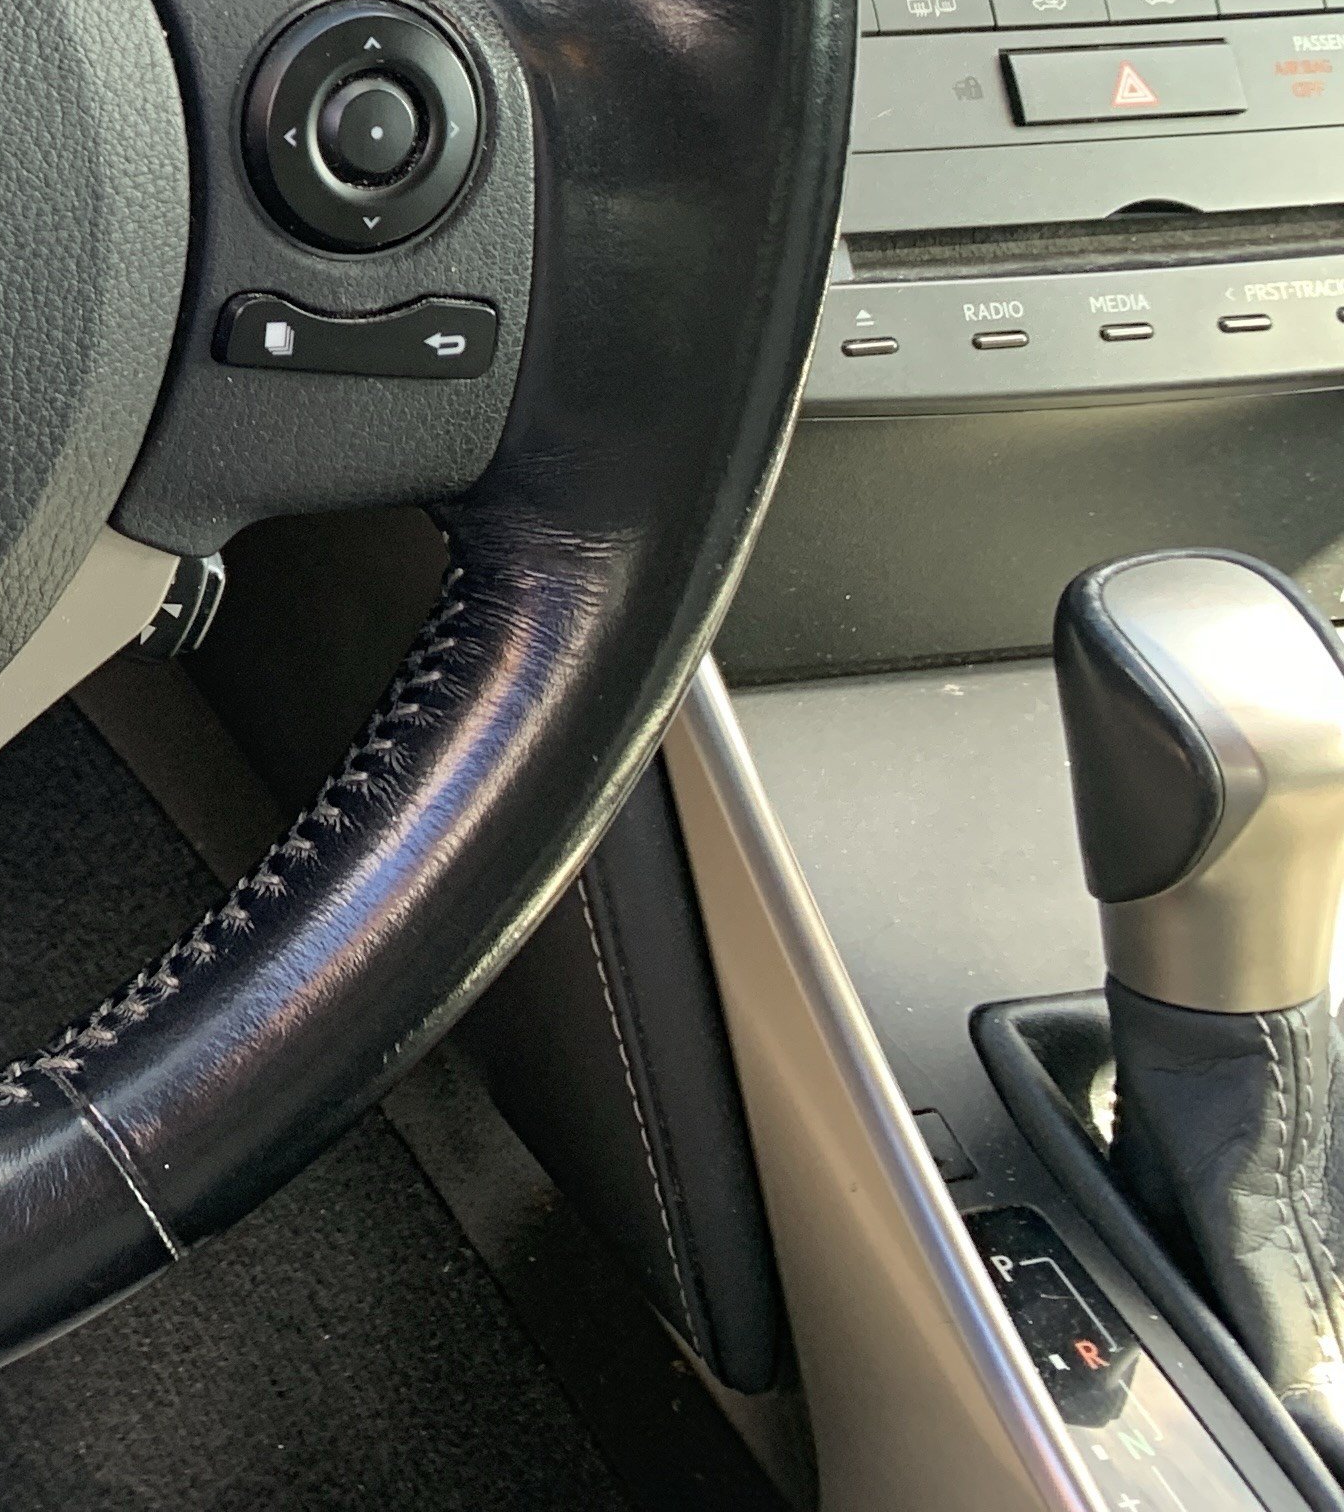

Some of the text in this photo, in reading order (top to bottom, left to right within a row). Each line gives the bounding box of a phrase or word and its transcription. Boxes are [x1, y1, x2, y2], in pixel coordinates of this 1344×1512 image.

[963, 300, 1024, 322] RADIO
[1089, 294, 1151, 314] MEDIA
[990, 1255, 1014, 1282] P
[1074, 1339, 1110, 1369] R
[1118, 1429, 1156, 1460] N
